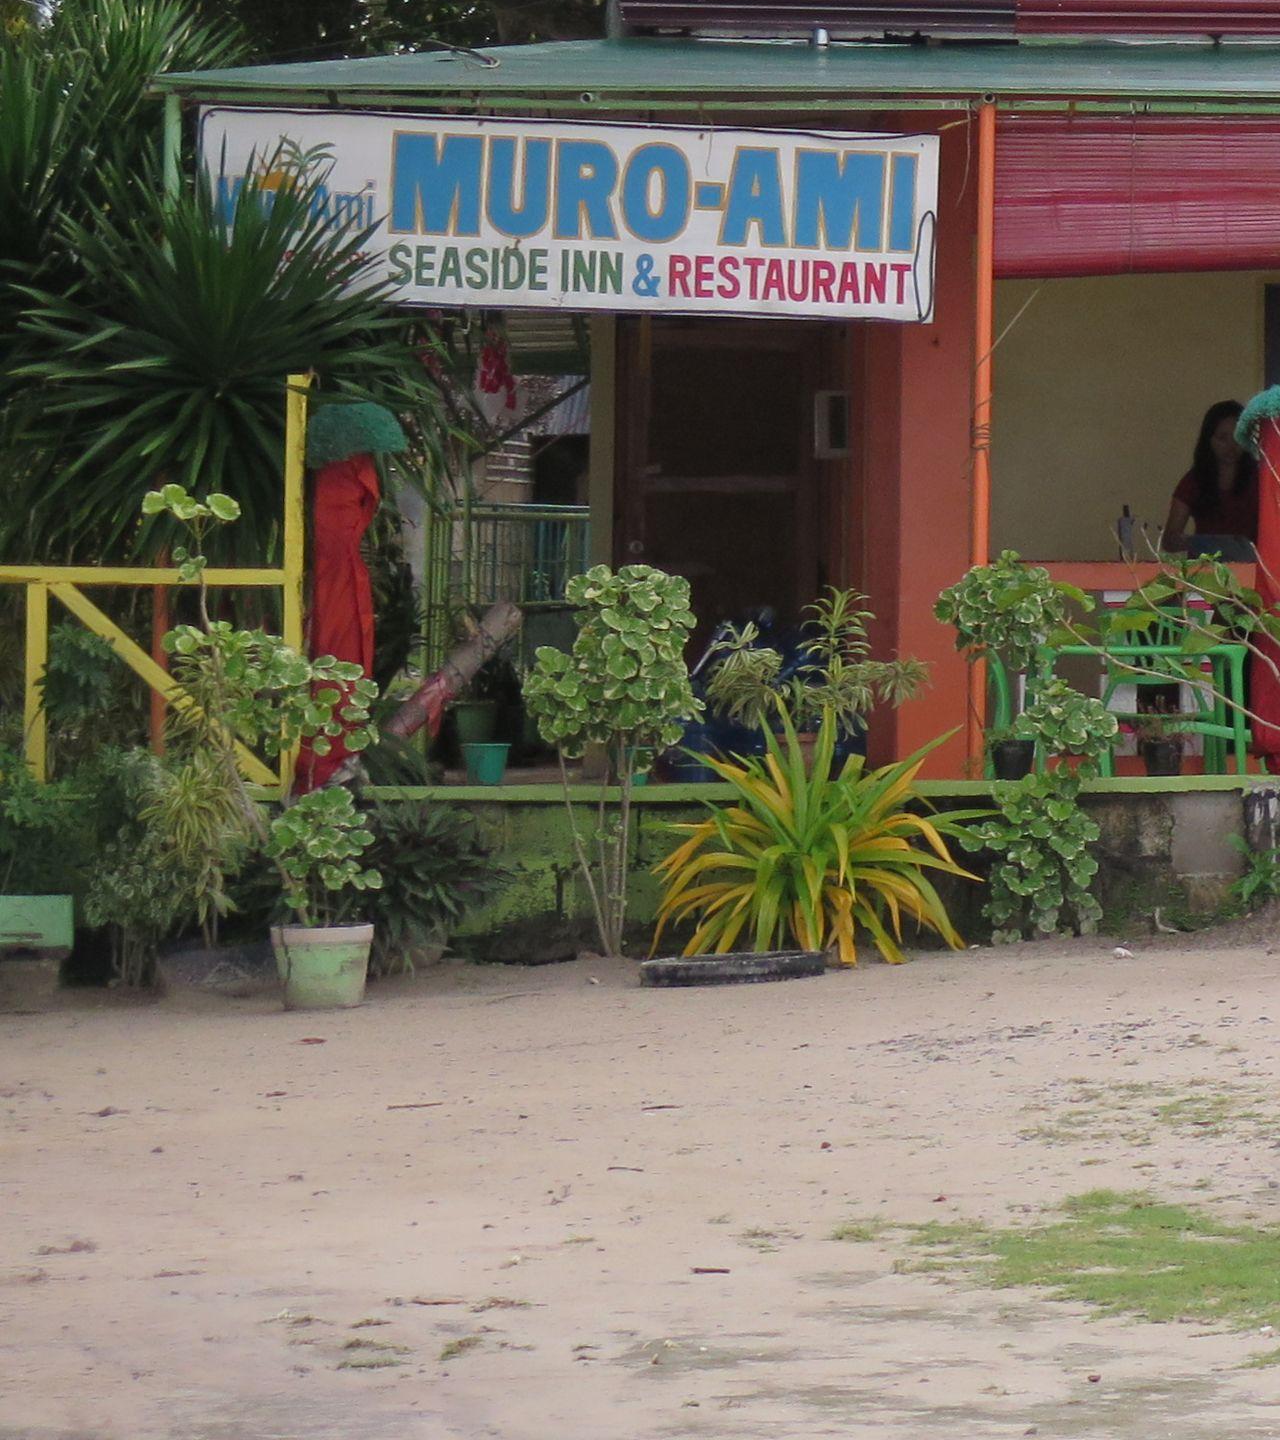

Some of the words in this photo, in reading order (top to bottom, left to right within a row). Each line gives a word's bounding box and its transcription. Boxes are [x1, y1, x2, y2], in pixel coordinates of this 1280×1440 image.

[388, 129, 919, 253] MURO-AMI
[388, 244, 549, 291] SEASIDE
[561, 248, 624, 295] INN
[632, 253, 661, 298] &
[668, 254, 912, 304] RESTAURANT
